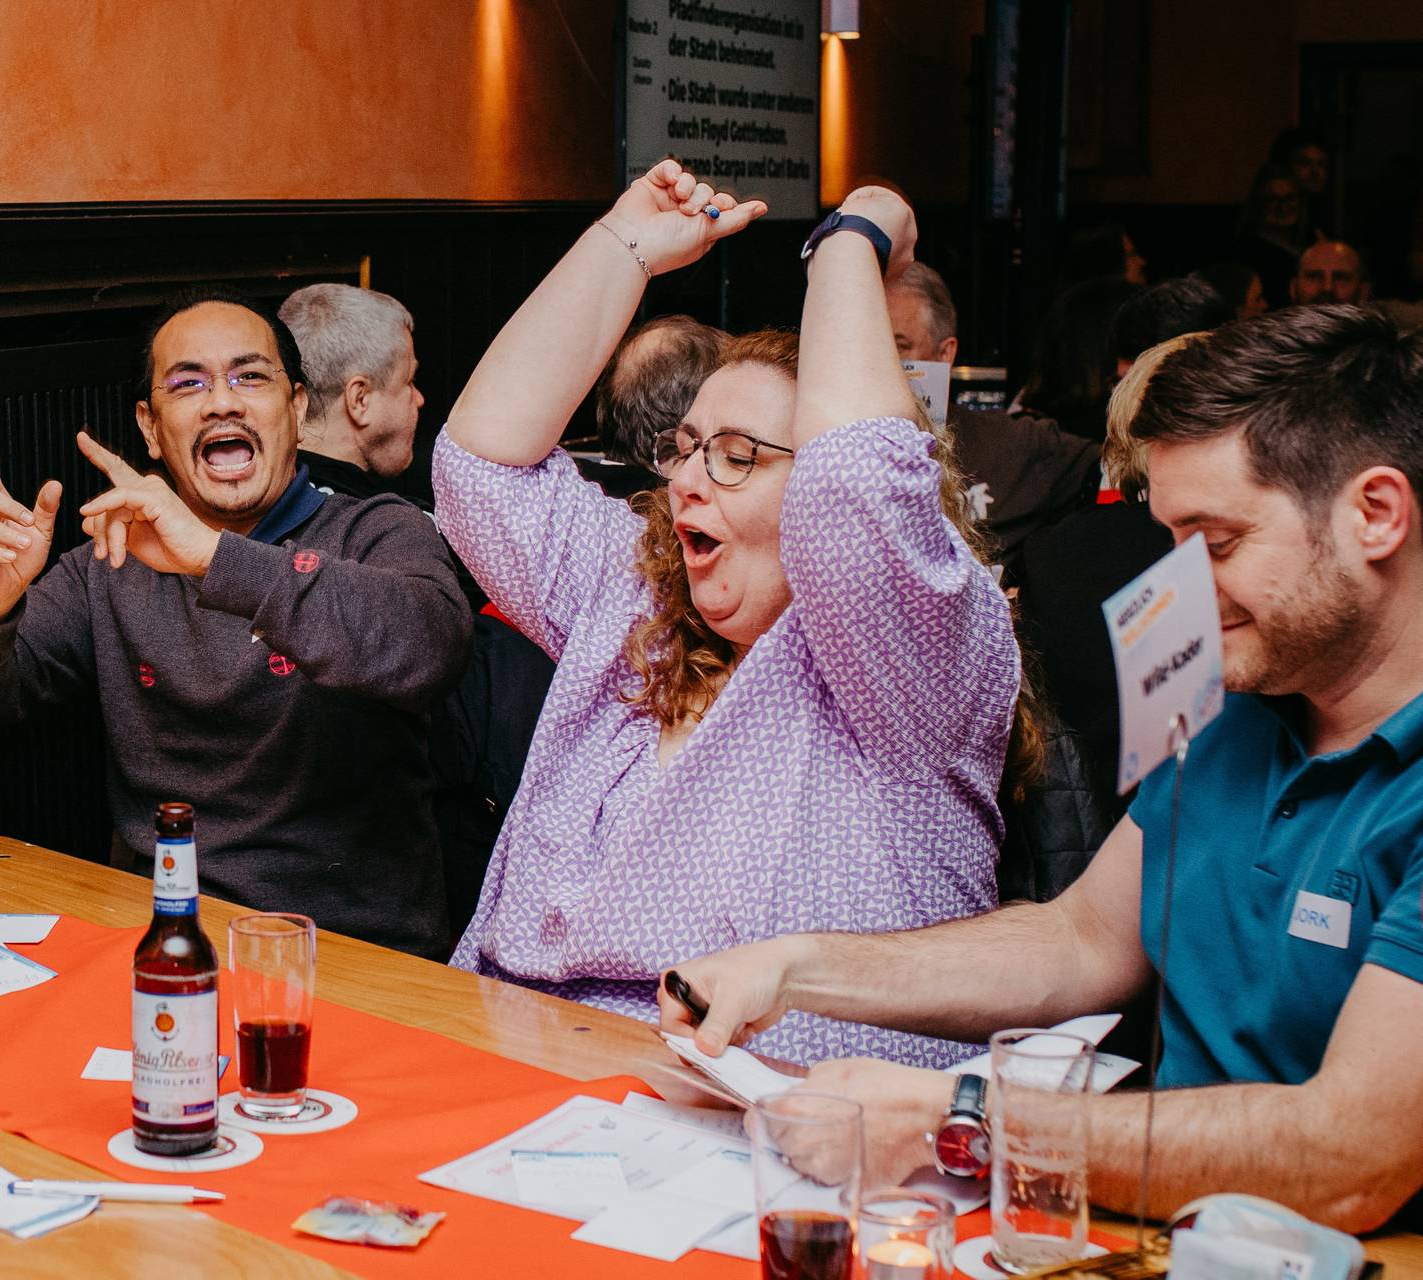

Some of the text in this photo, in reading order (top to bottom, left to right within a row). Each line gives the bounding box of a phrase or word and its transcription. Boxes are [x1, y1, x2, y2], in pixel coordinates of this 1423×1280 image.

[668, 32, 688, 57] der
[689, 36, 717, 61] Stadt
[668, 77, 686, 102] Die
[688, 81, 716, 105] Stadt
[717, 86, 749, 108] wurde
[668, 114, 699, 139] durch
[701, 117, 729, 147] Floyd
[713, 155, 746, 183] Scarpa
[748, 156, 766, 177] und
[768, 157, 785, 178] Carl
